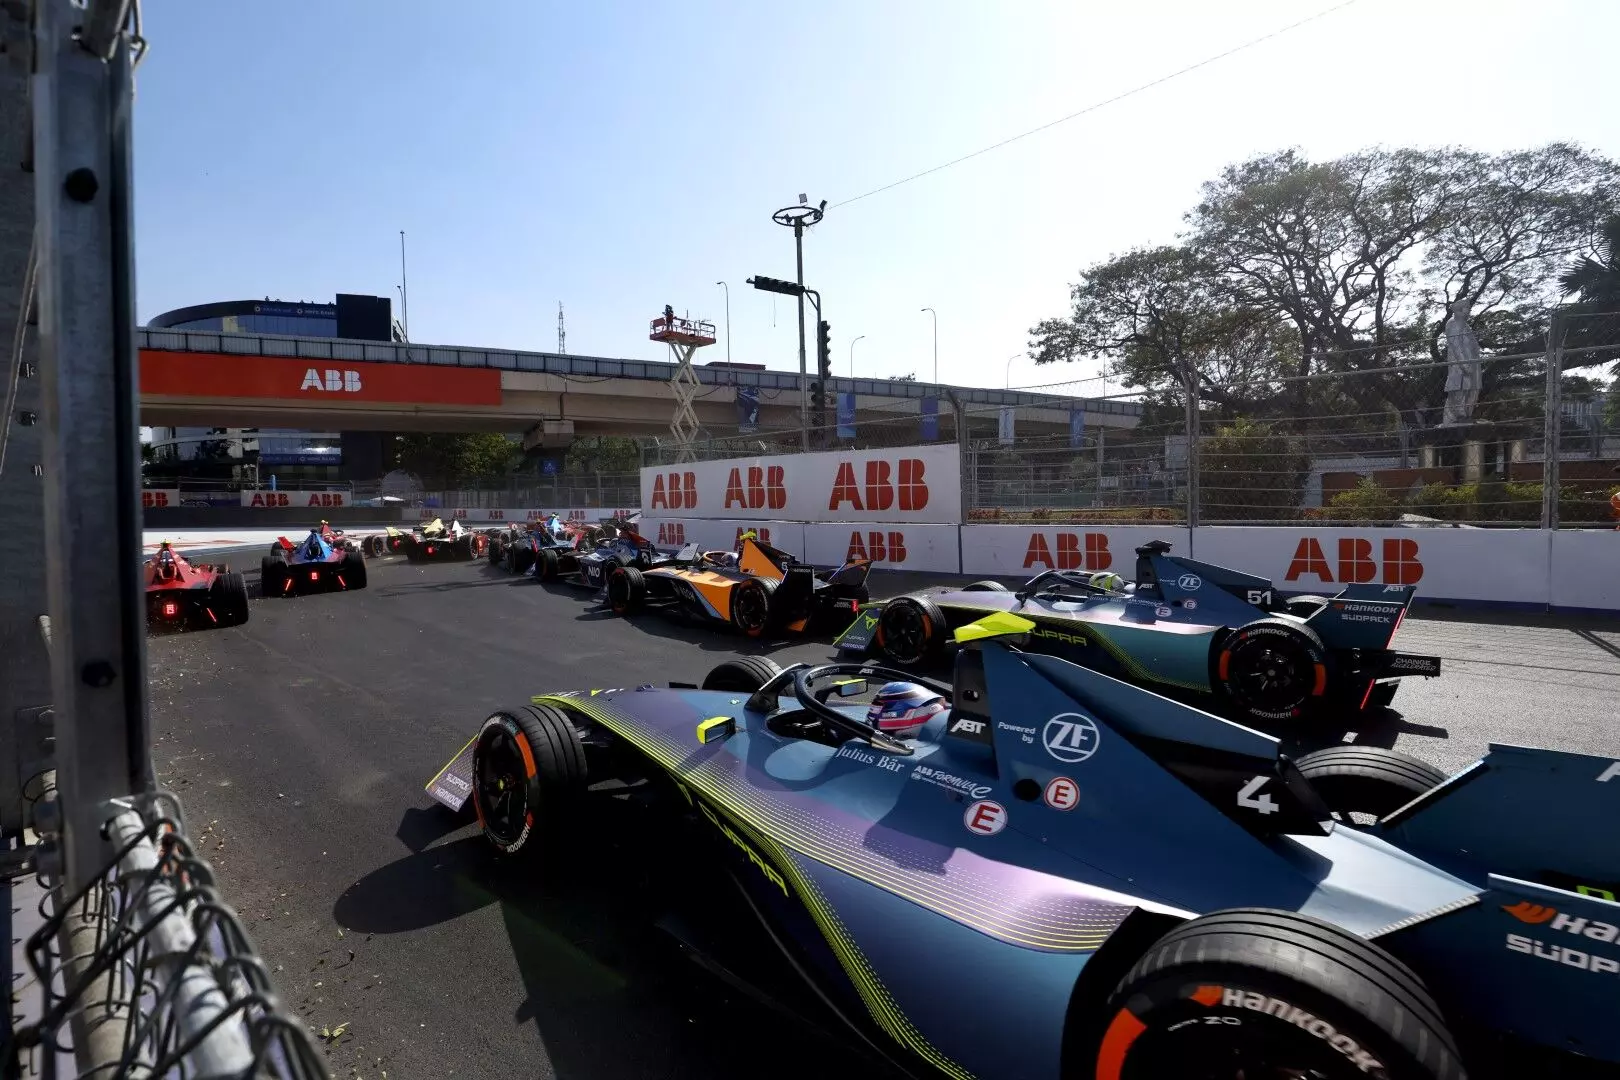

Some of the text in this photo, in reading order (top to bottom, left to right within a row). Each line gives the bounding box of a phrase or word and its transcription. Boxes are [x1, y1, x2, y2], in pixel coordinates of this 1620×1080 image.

[301, 368, 362, 392] ABB
[651, 471, 698, 509] ABB
[725, 466, 787, 509] ABB
[828, 459, 929, 511] ABB
[251, 493, 289, 507] ABB
[308, 493, 344, 507] ABB
[658, 523, 685, 545] ABB
[846, 531, 907, 563] ABB
[1023, 533, 1113, 571] ABB
[1284, 538, 1424, 585] ABB
[1181, 576, 1199, 588] ZF
[1382, 585, 1406, 593] ABT
[1247, 590, 1272, 605] 51
[1344, 604, 1398, 614] Hankook
[1030, 629, 1088, 648] UPRA
[859, 667, 875, 675] ABT
[951, 719, 986, 735] ABT
[998, 721, 1036, 735] Powered
[1022, 734, 1034, 744] by
[1049, 719, 1095, 755] ZF
[837, 745, 905, 773] Julius Bär
[914, 765, 934, 776] ABB
[931, 770, 978, 791] FORMULA
[1053, 785, 1073, 805] E
[1237, 775, 1280, 815] 4
[970, 803, 1000, 832] E
[1550, 913, 1620, 945] Ha
[1222, 987, 1385, 1073] Hankook
